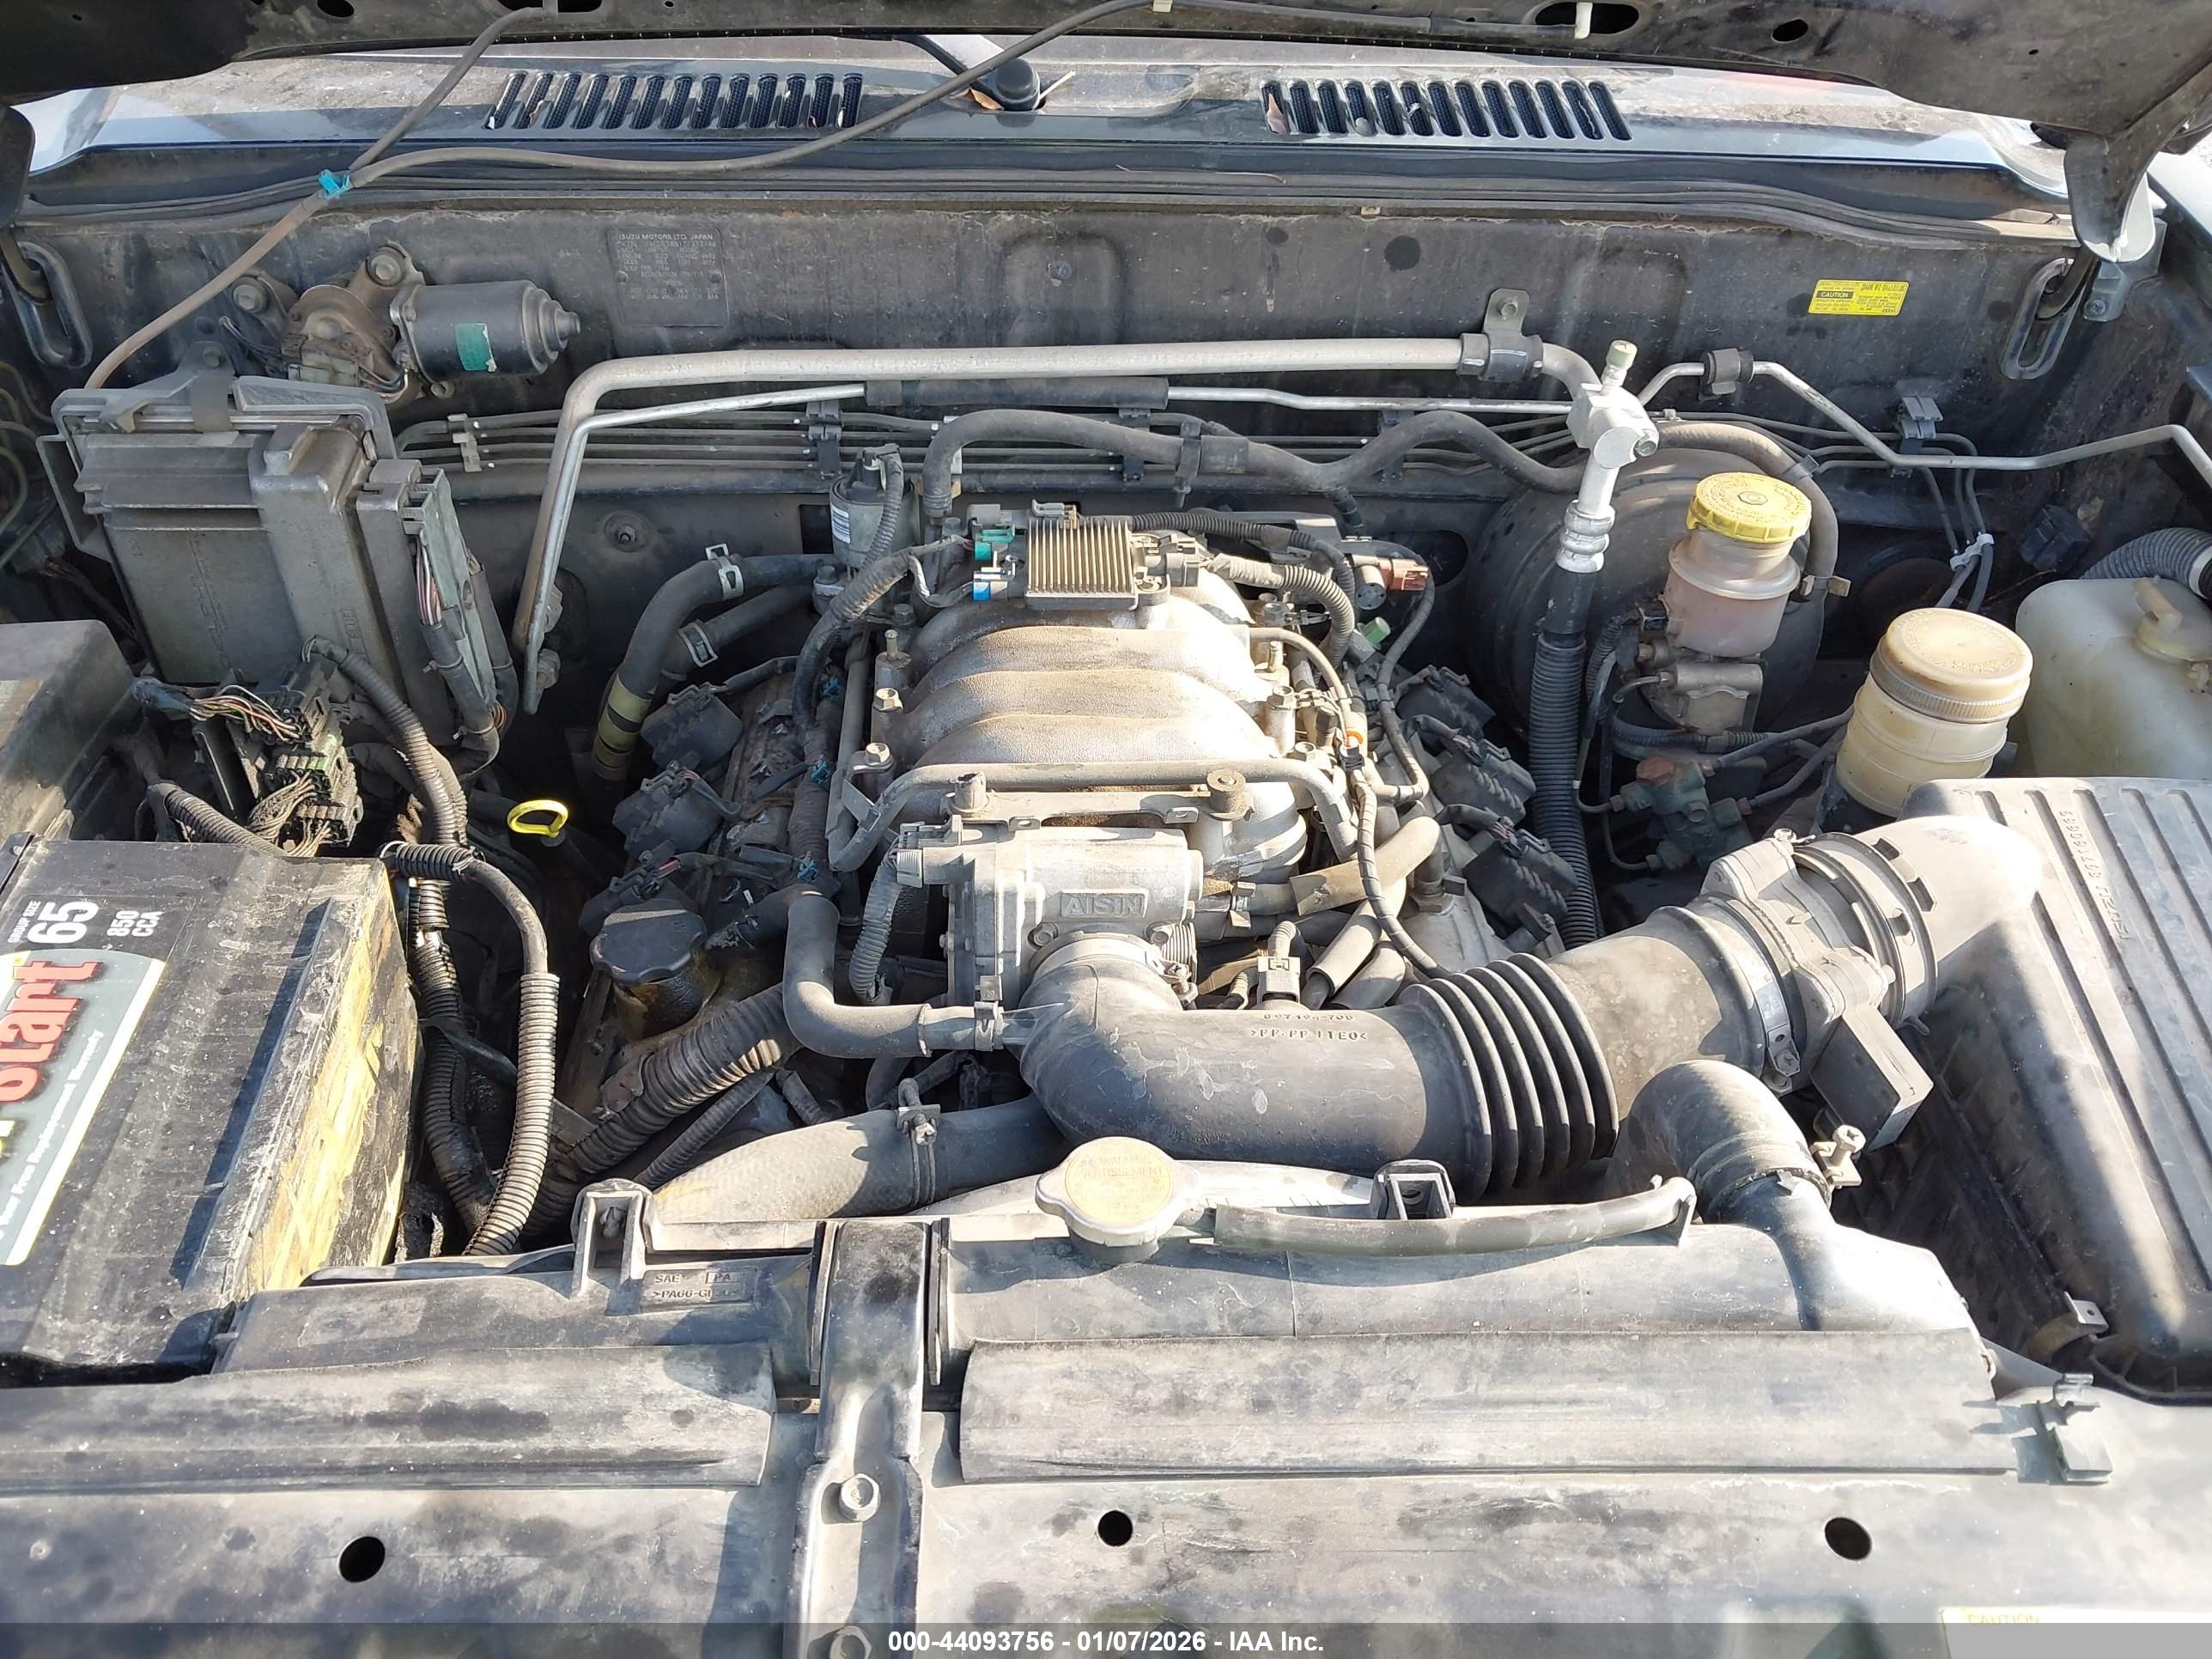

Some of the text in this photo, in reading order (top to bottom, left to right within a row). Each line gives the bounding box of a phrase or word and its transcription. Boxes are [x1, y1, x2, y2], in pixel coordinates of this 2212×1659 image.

[1065, 896, 1143, 915] AISIN
[8, 900, 41, 943] GROUP SIZE
[27, 902, 99, 944] 65
[107, 910, 140, 937] 850
[131, 911, 164, 937] CCA
[654, 1273, 682, 1284] SAE
[1966, 1613, 2041, 1626] CAUTION
